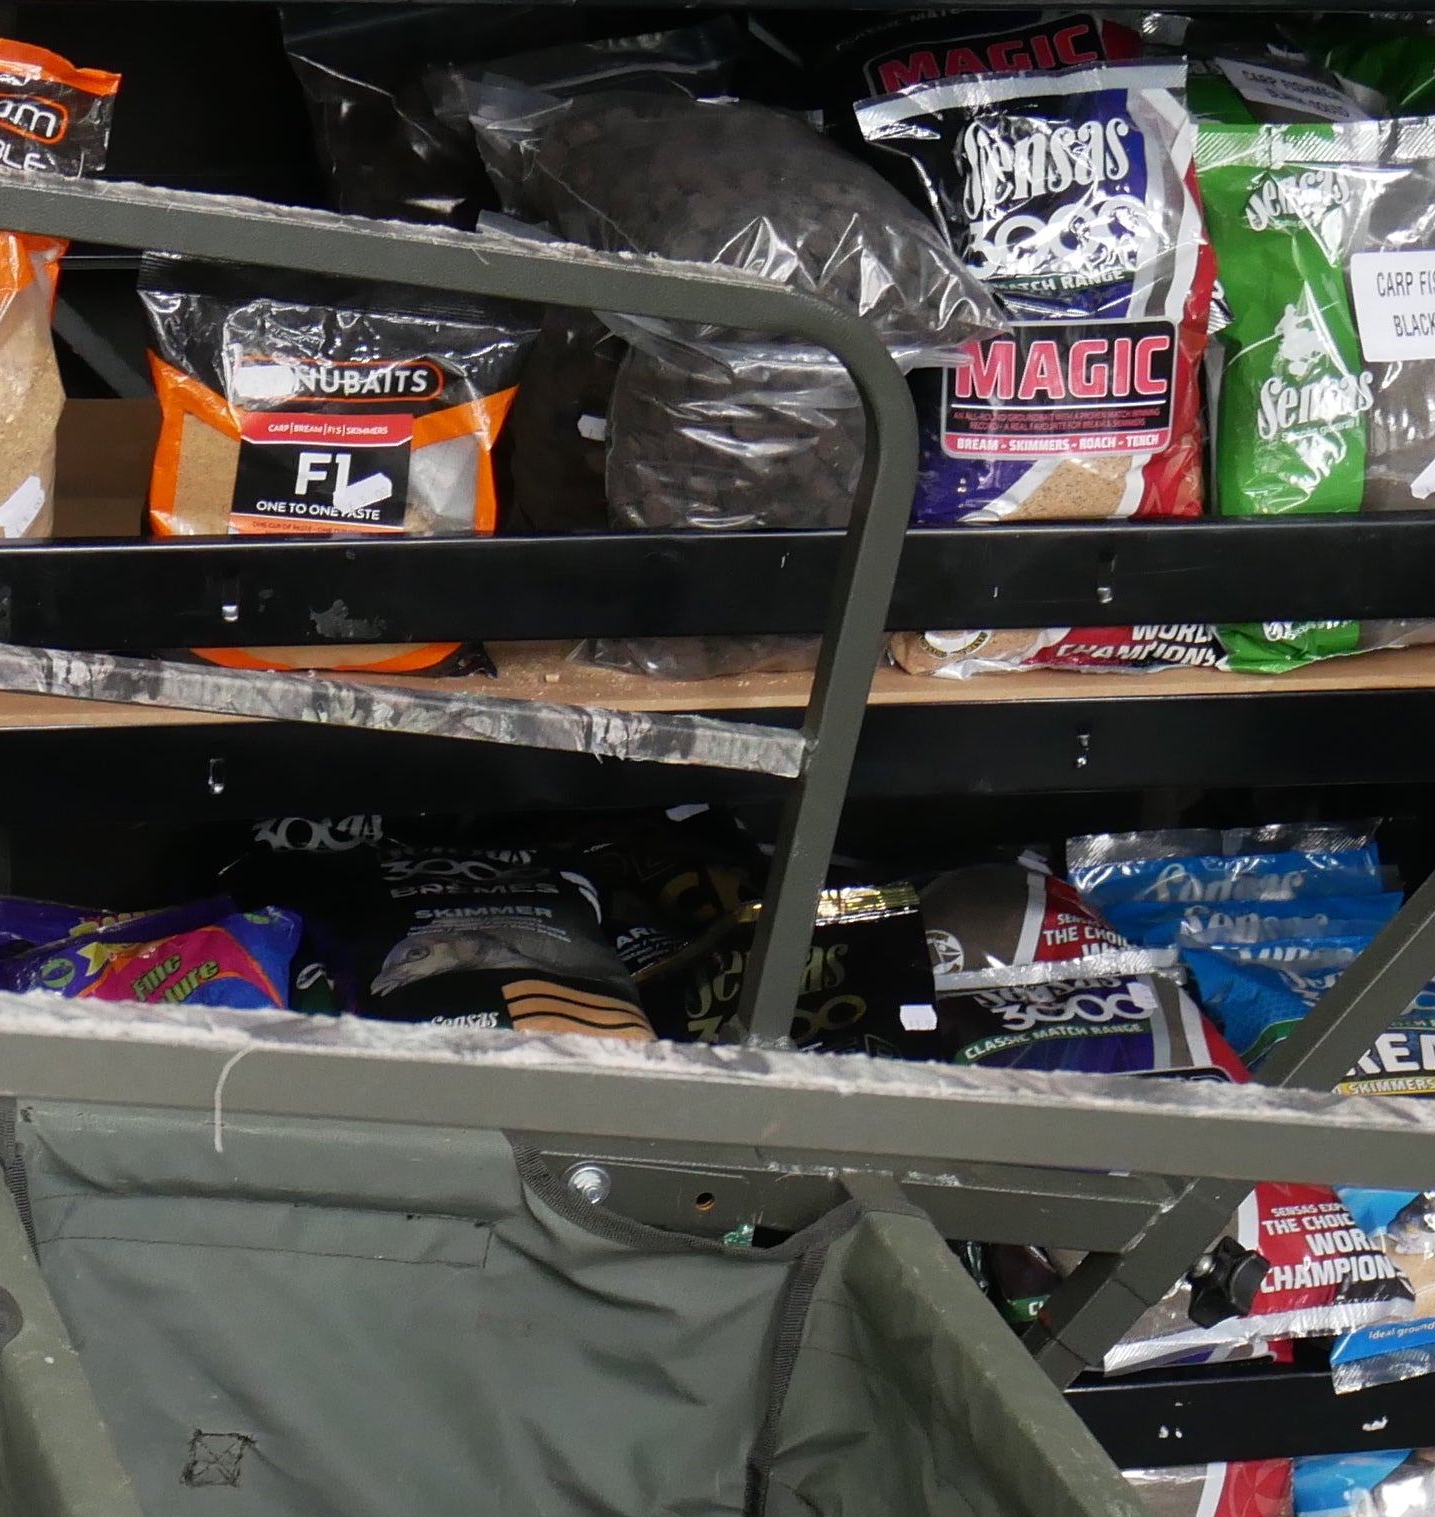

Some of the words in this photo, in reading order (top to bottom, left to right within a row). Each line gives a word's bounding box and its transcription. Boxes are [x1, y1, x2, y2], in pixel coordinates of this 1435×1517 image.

[878, 24, 1098, 94] MAGIC
[964, 118, 1129, 220] Sensas
[1063, 267, 1126, 290] RANGE
[1377, 271, 1413, 297] CARP
[955, 336, 1170, 399] MAGIC
[296, 368, 429, 394] NUBAITS
[268, 423, 289, 433] CARP
[294, 424, 323, 434] BREAM
[957, 437, 999, 451] BREAM
[1009, 438, 1070, 451] SKIMMERS
[1080, 436, 1116, 449] ROACH
[1126, 434, 1160, 447] TENCH
[256, 500, 286, 513] ONE
[289, 503, 307, 515] TO
[308, 504, 339, 517] ONE
[390, 882, 560, 899] BREMES
[414, 905, 553, 920] SKIMMER
[1044, 928, 1079, 946] THE
[965, 1034, 1031, 1060] CLASSIC
[1033, 1026, 1090, 1041] MATCH
[1092, 1023, 1143, 1035] RANGE
[1270, 1204, 1318, 1218] SENSAS
[1262, 1217, 1302, 1236] THE
[1368, 1327, 1397, 1340] Ideal
